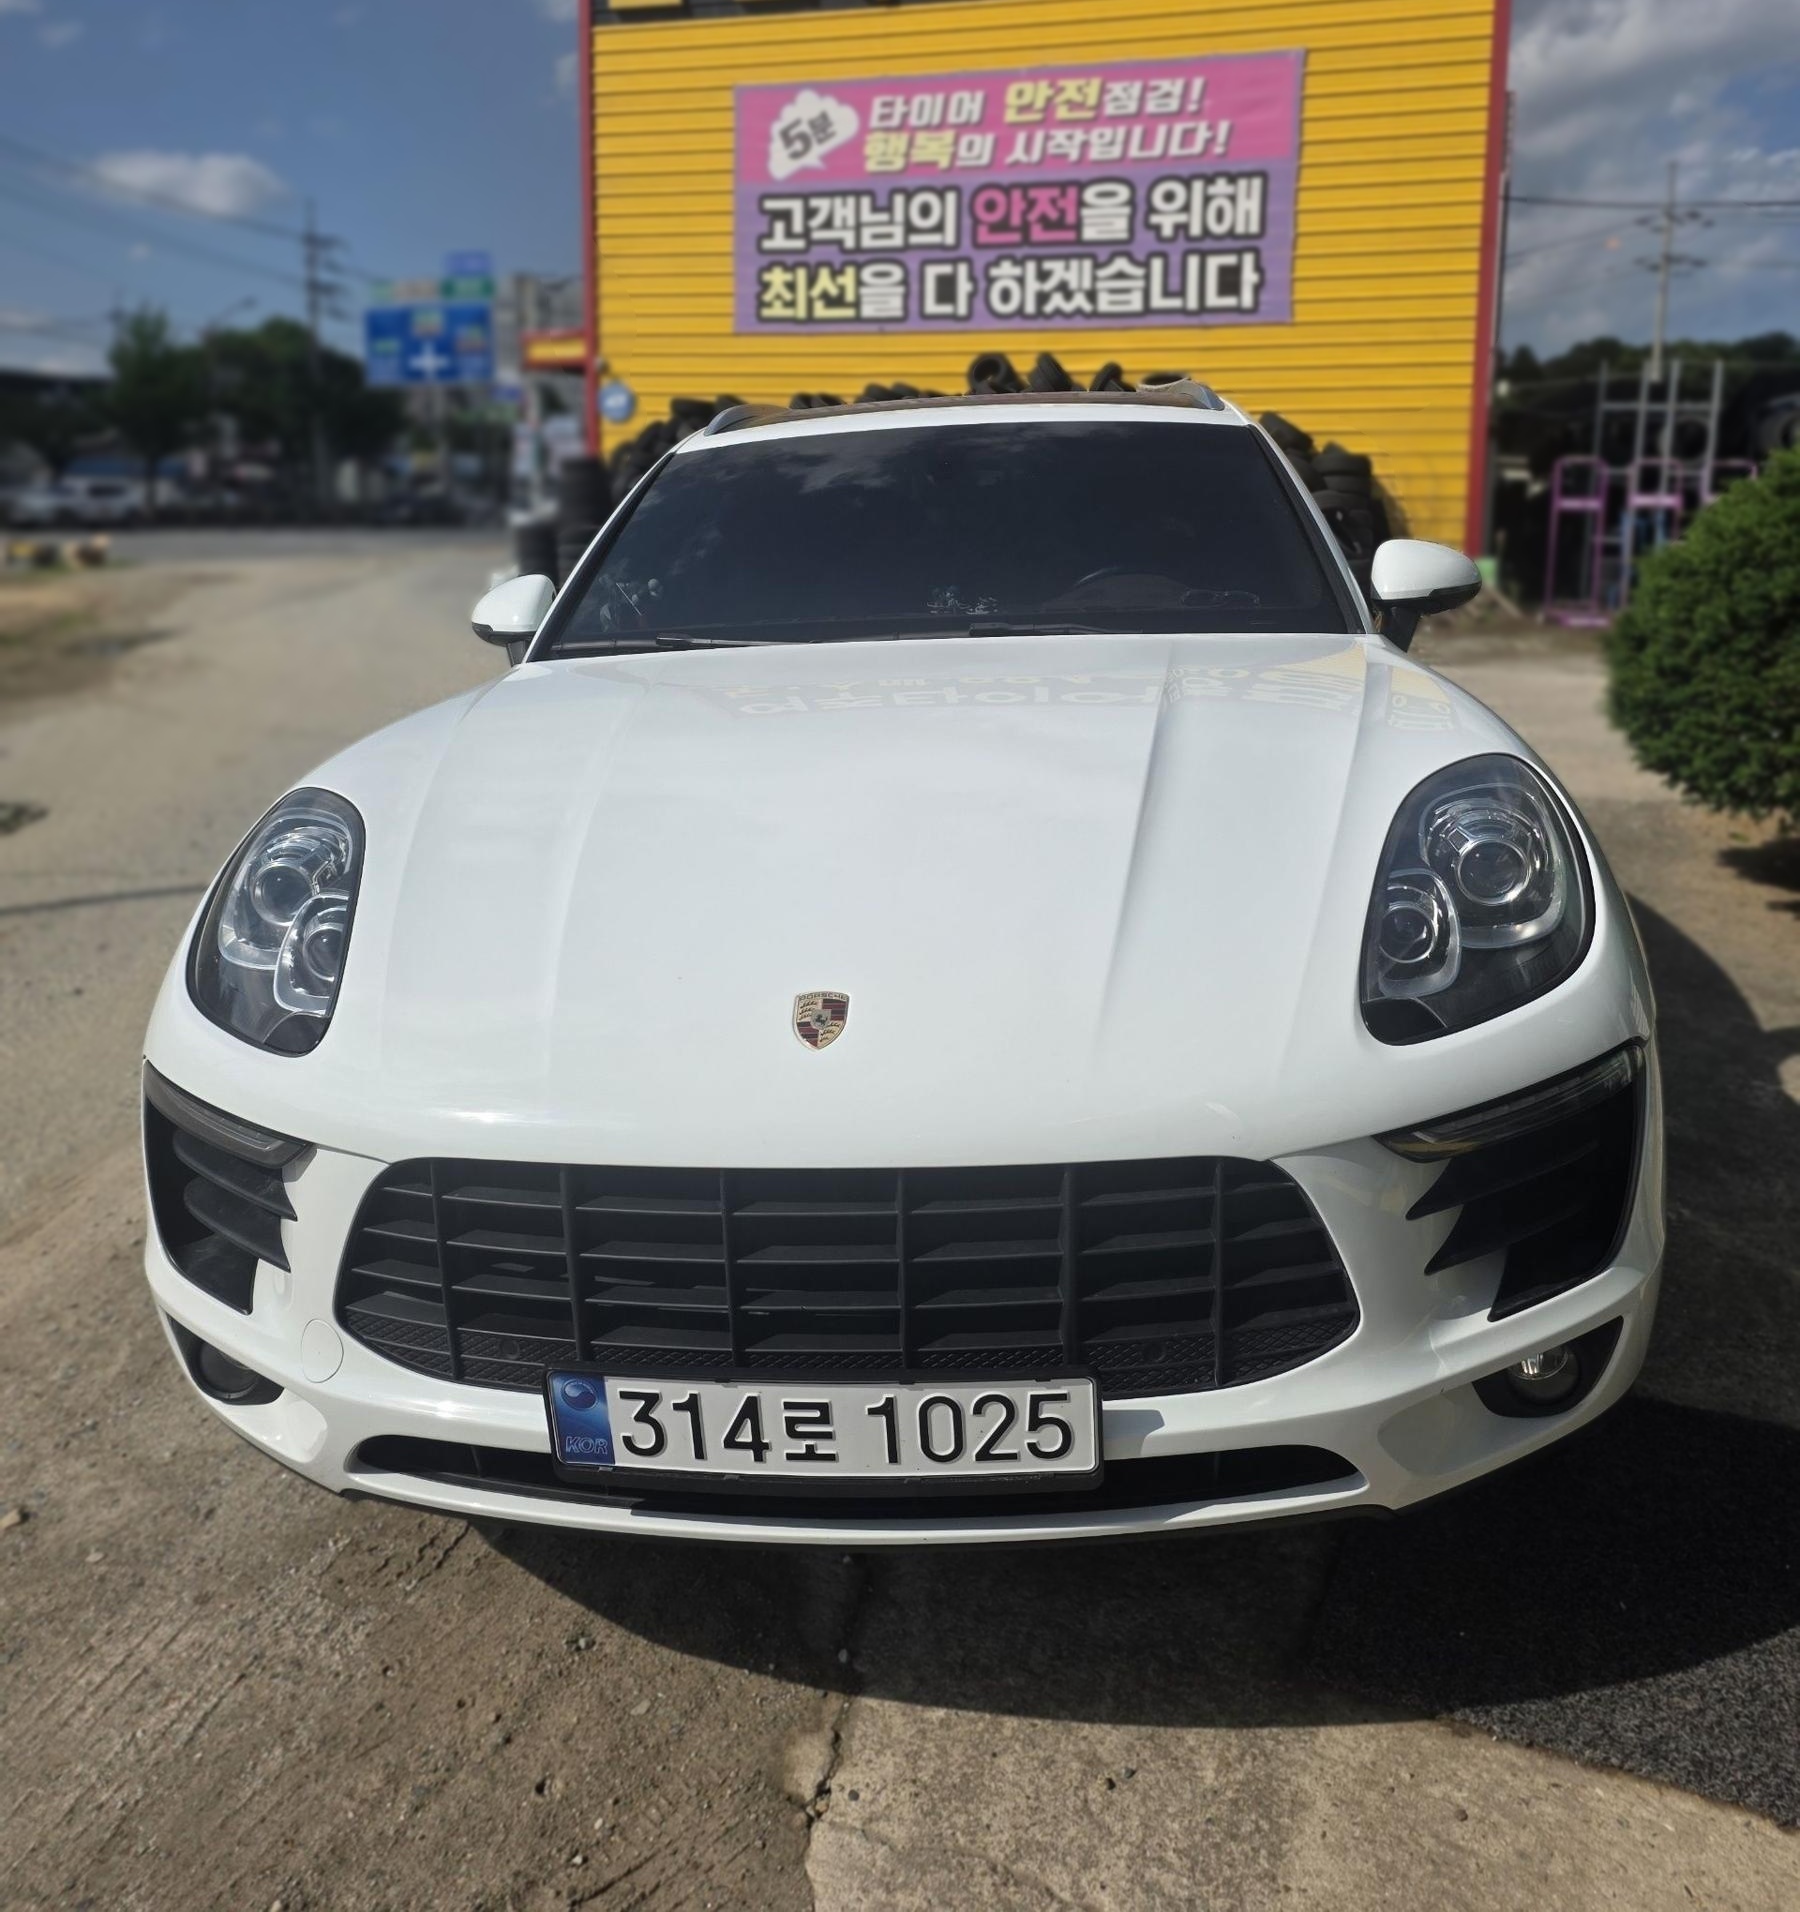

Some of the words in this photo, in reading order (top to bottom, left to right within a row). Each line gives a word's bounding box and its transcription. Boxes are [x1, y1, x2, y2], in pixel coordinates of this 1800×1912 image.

[868, 90, 985, 128] 타이어
[1004, 77, 1204, 123] 안전점검!
[778, 109, 837, 161] 5분
[864, 130, 995, 173] 행복의
[1004, 120, 1230, 165] 시작입니다!
[760, 190, 958, 250] 고객님의
[972, 181, 1133, 245] 안전을
[1147, 175, 1264, 239] 위해
[759, 263, 906, 320] 최선을
[922, 261, 974, 318] 다
[988, 251, 1261, 316] 하겠습니다
[565, 1435, 609, 1455] KOR
[617, 1390, 839, 1463] 314로
[866, 1391, 1074, 1464] 1025
